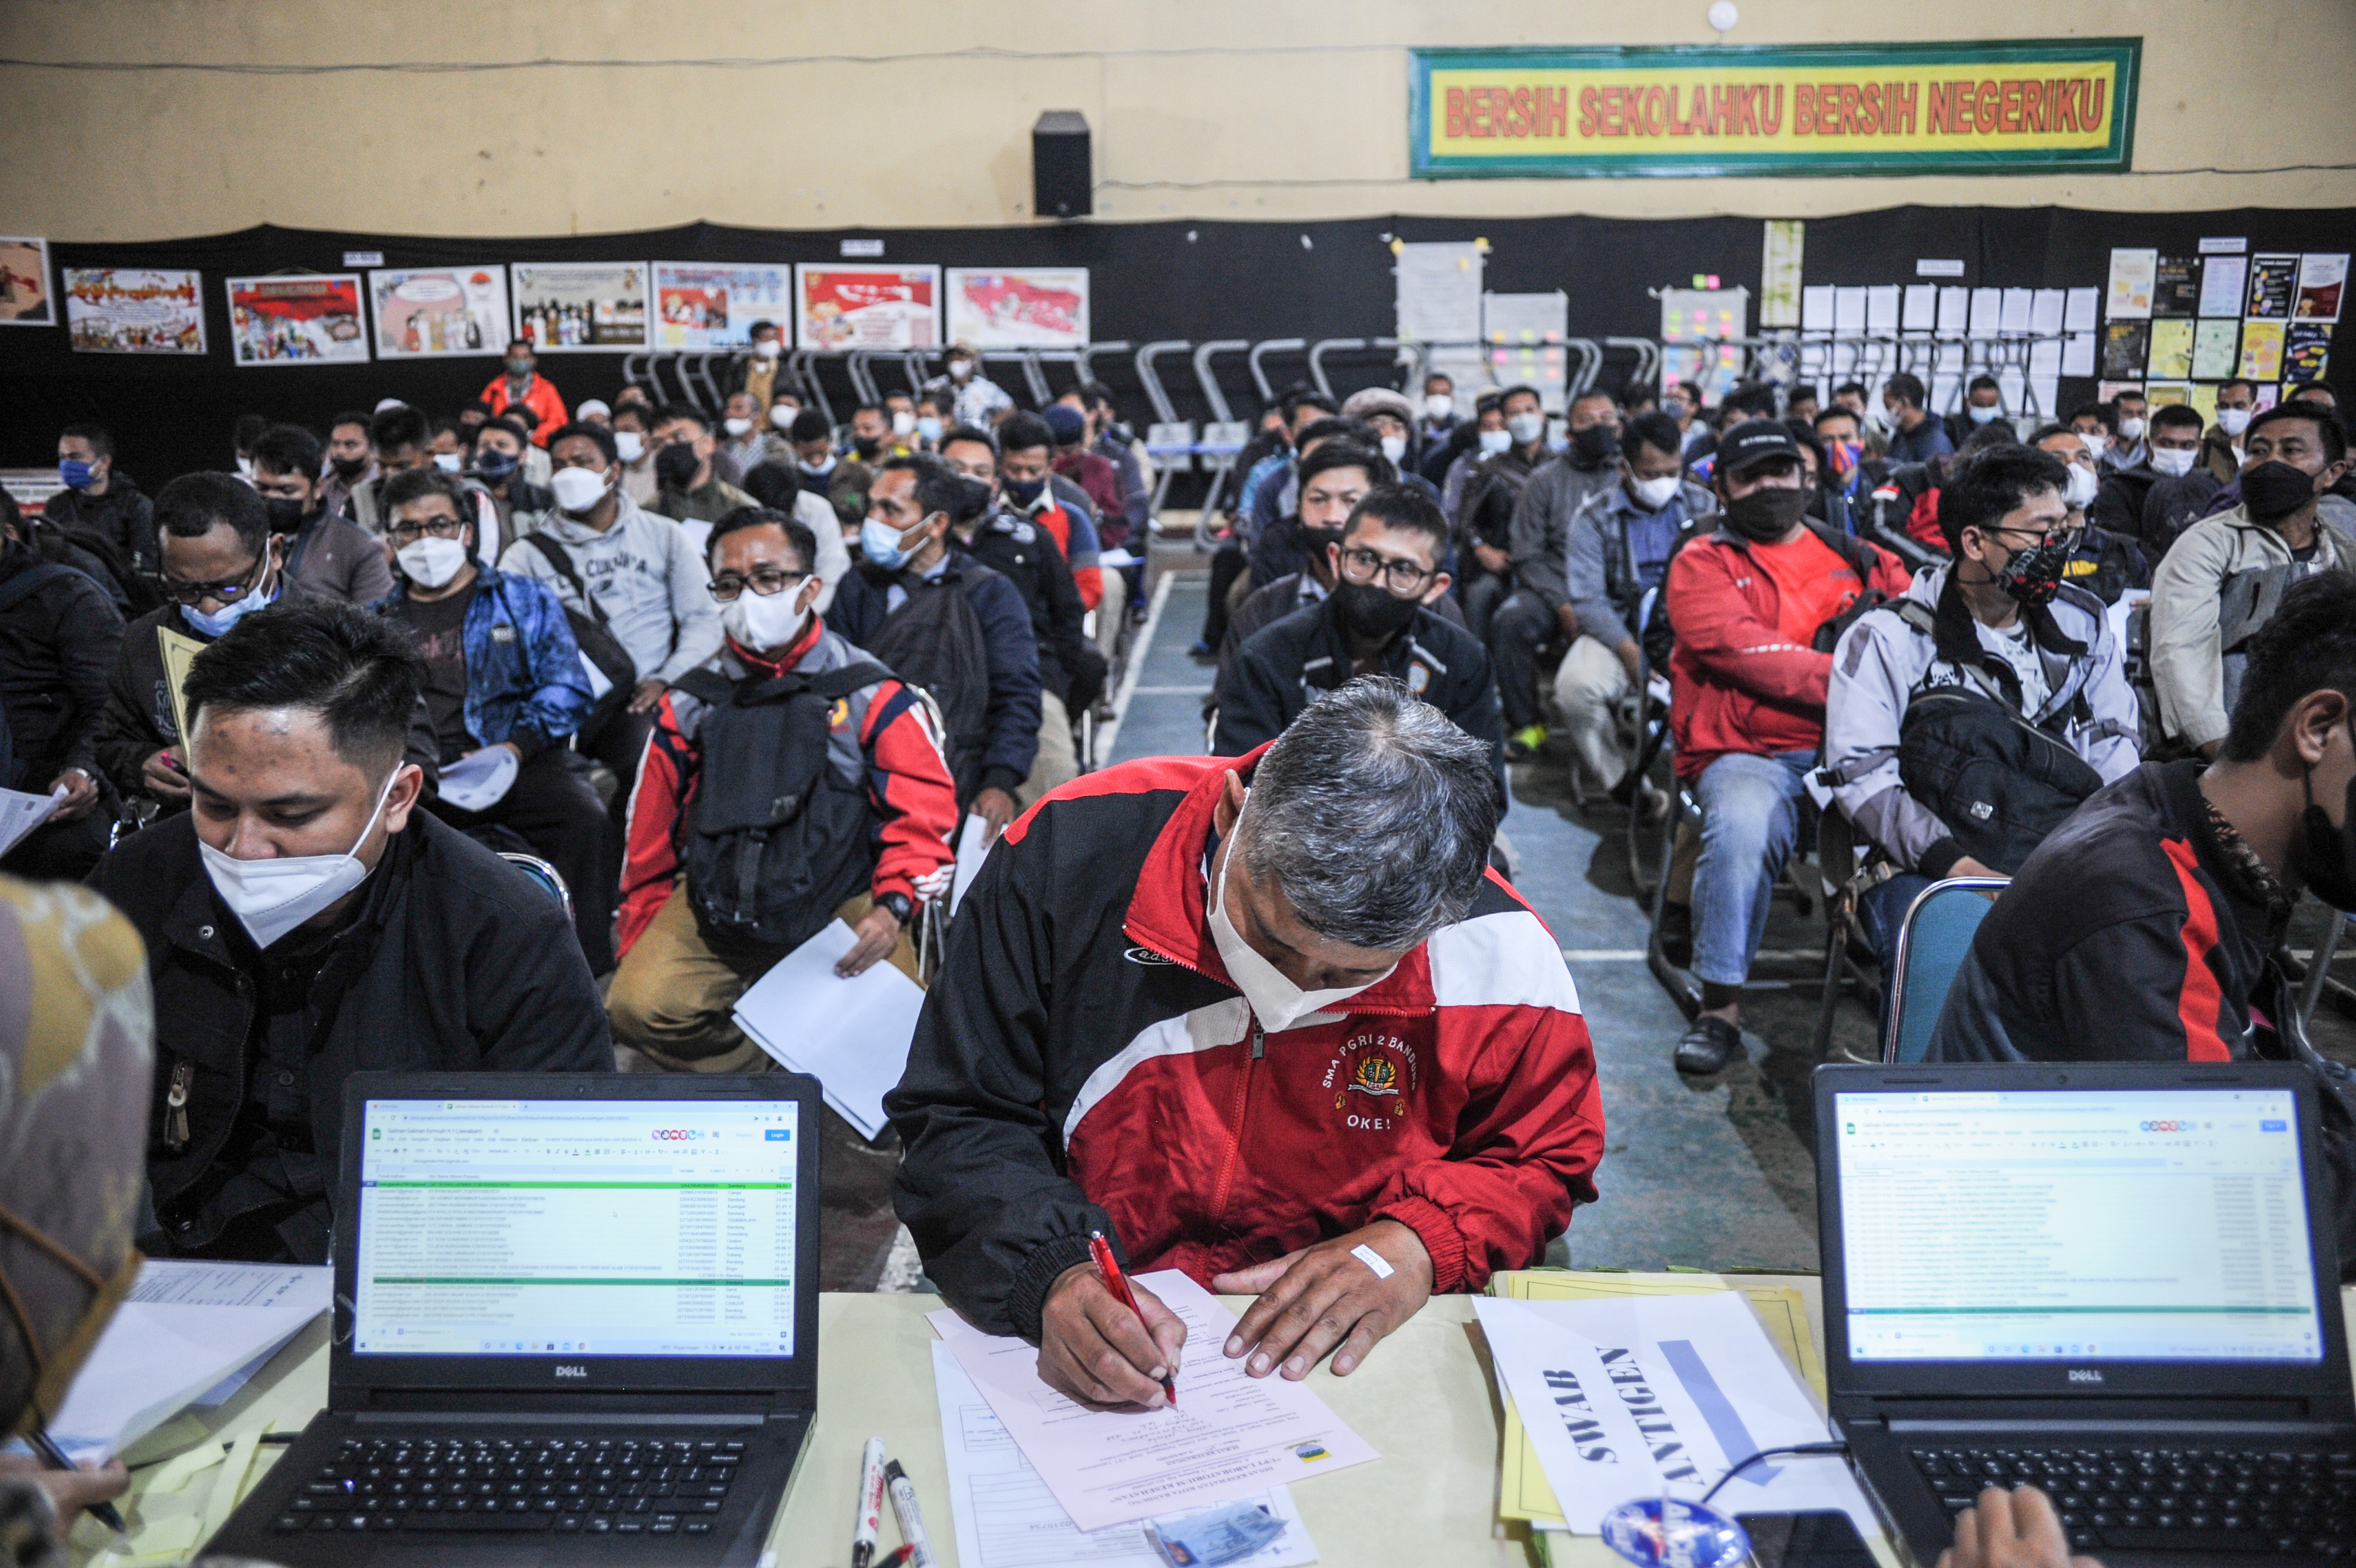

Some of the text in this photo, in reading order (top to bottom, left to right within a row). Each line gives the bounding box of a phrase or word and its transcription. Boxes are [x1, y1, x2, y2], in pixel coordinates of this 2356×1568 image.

[1444, 78, 2106, 138] BERSIH SEKOLAHKU BERSIH NEGERIKU
[1323, 1059, 1340, 1088] SMA
[1339, 1034, 1372, 1056] PGRI
[1377, 1036, 1386, 1046] 2
[1347, 1115, 1391, 1130] OKE!
[556, 1366, 587, 1377] DELL
[2069, 1369, 2102, 1381] DELL
[1543, 1370, 1619, 1463] SWAB
[1595, 1346, 1706, 1486] ANTIGEN
[1128, 1466, 1273, 1506] DINAS KESEHATAN KOTA BANDUNG
[1176, 1463, 1255, 1486] LABORATORIUM
